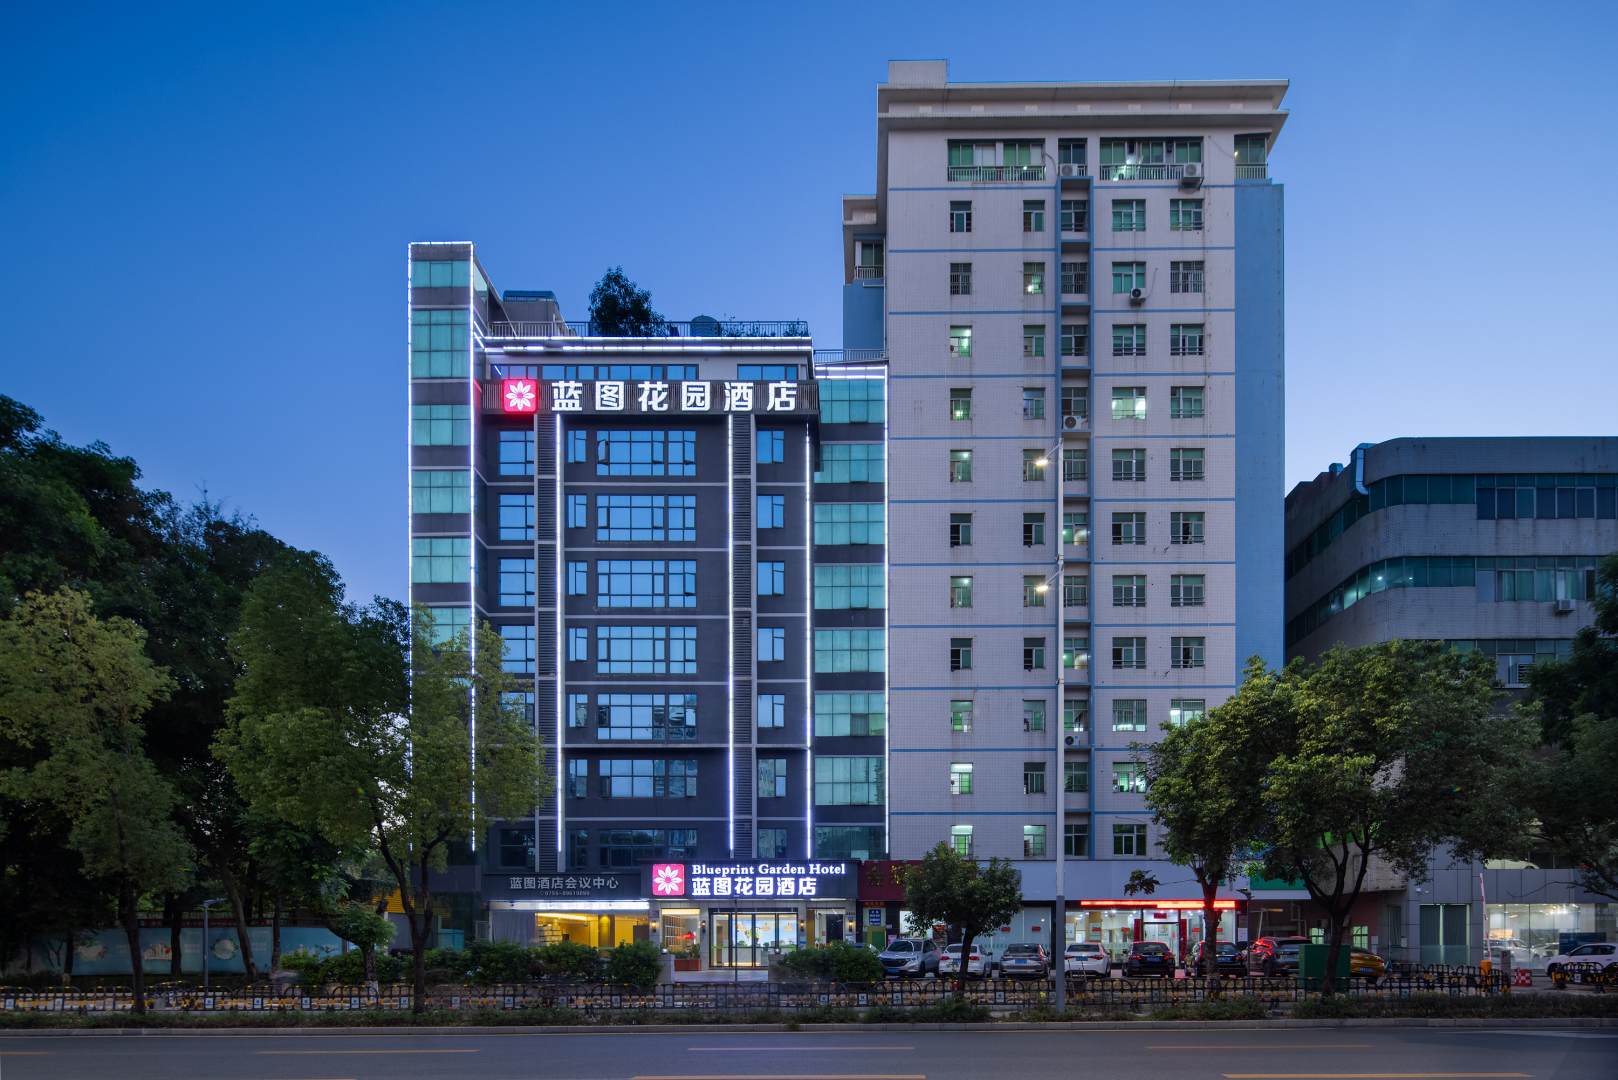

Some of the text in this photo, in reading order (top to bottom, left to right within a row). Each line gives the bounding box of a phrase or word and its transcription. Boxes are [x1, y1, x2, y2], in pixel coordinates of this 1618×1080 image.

[551, 380, 798, 412] 蓝图花园酒店
[692, 863, 846, 877] Blueprint Garden Hotel
[509, 876, 619, 889] 蓝图酒店会议中心
[691, 877, 817, 896] 蓝图花园酒店
